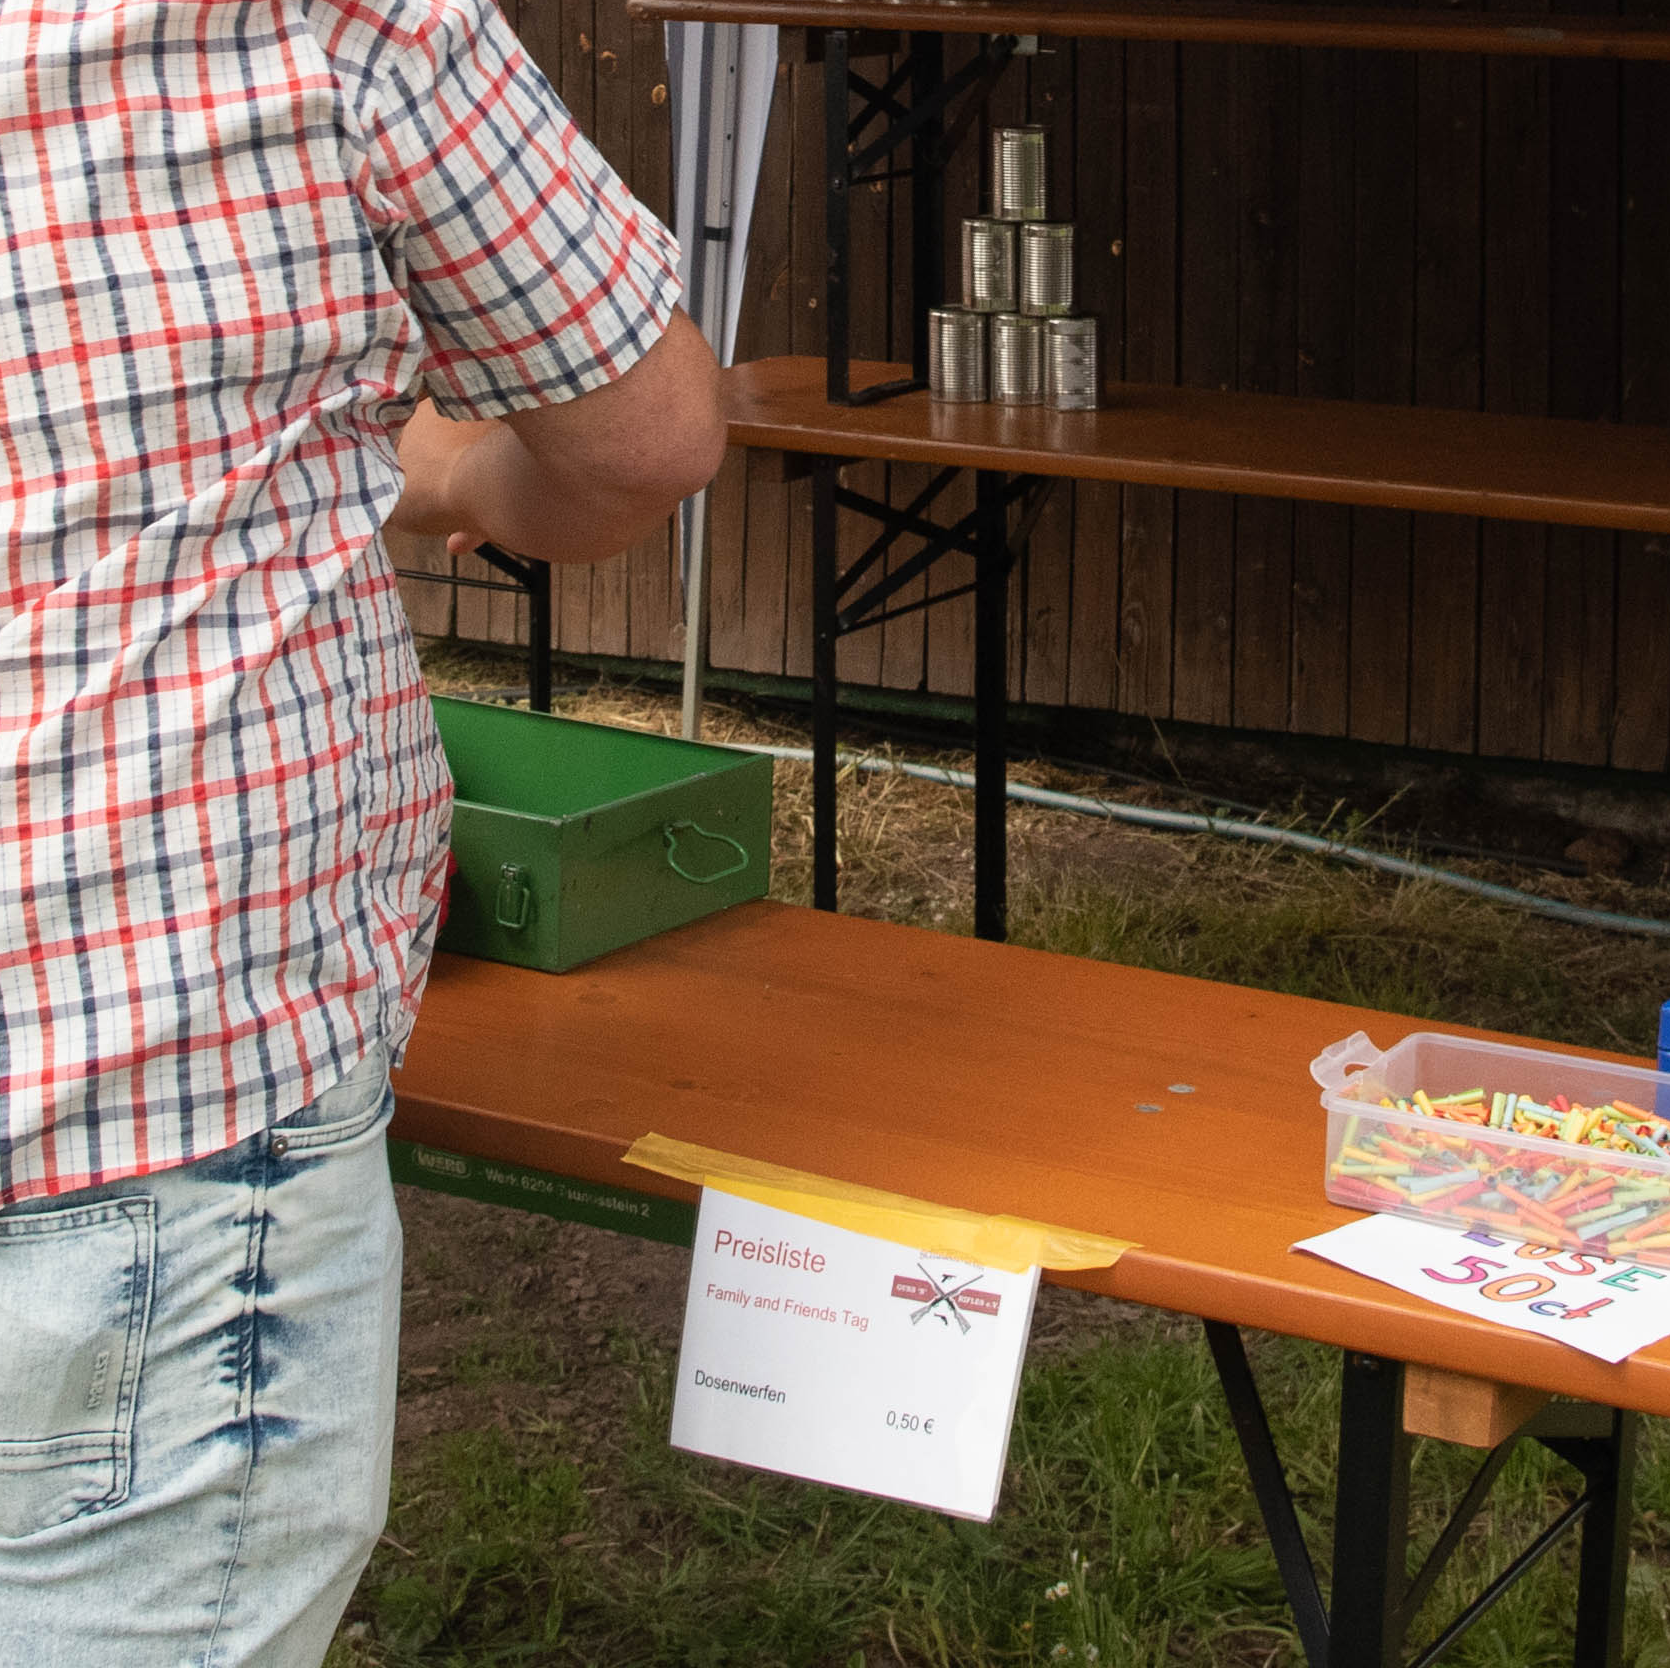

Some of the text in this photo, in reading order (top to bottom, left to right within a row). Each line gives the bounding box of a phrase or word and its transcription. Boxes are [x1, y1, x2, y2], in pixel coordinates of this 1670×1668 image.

[714, 1229, 826, 1274] Preisliste
[706, 1283, 870, 1332] Family and Friends Tag
[694, 1369, 787, 1404] Dosenwerfen
[886, 1410, 935, 1434] 0,50 €
